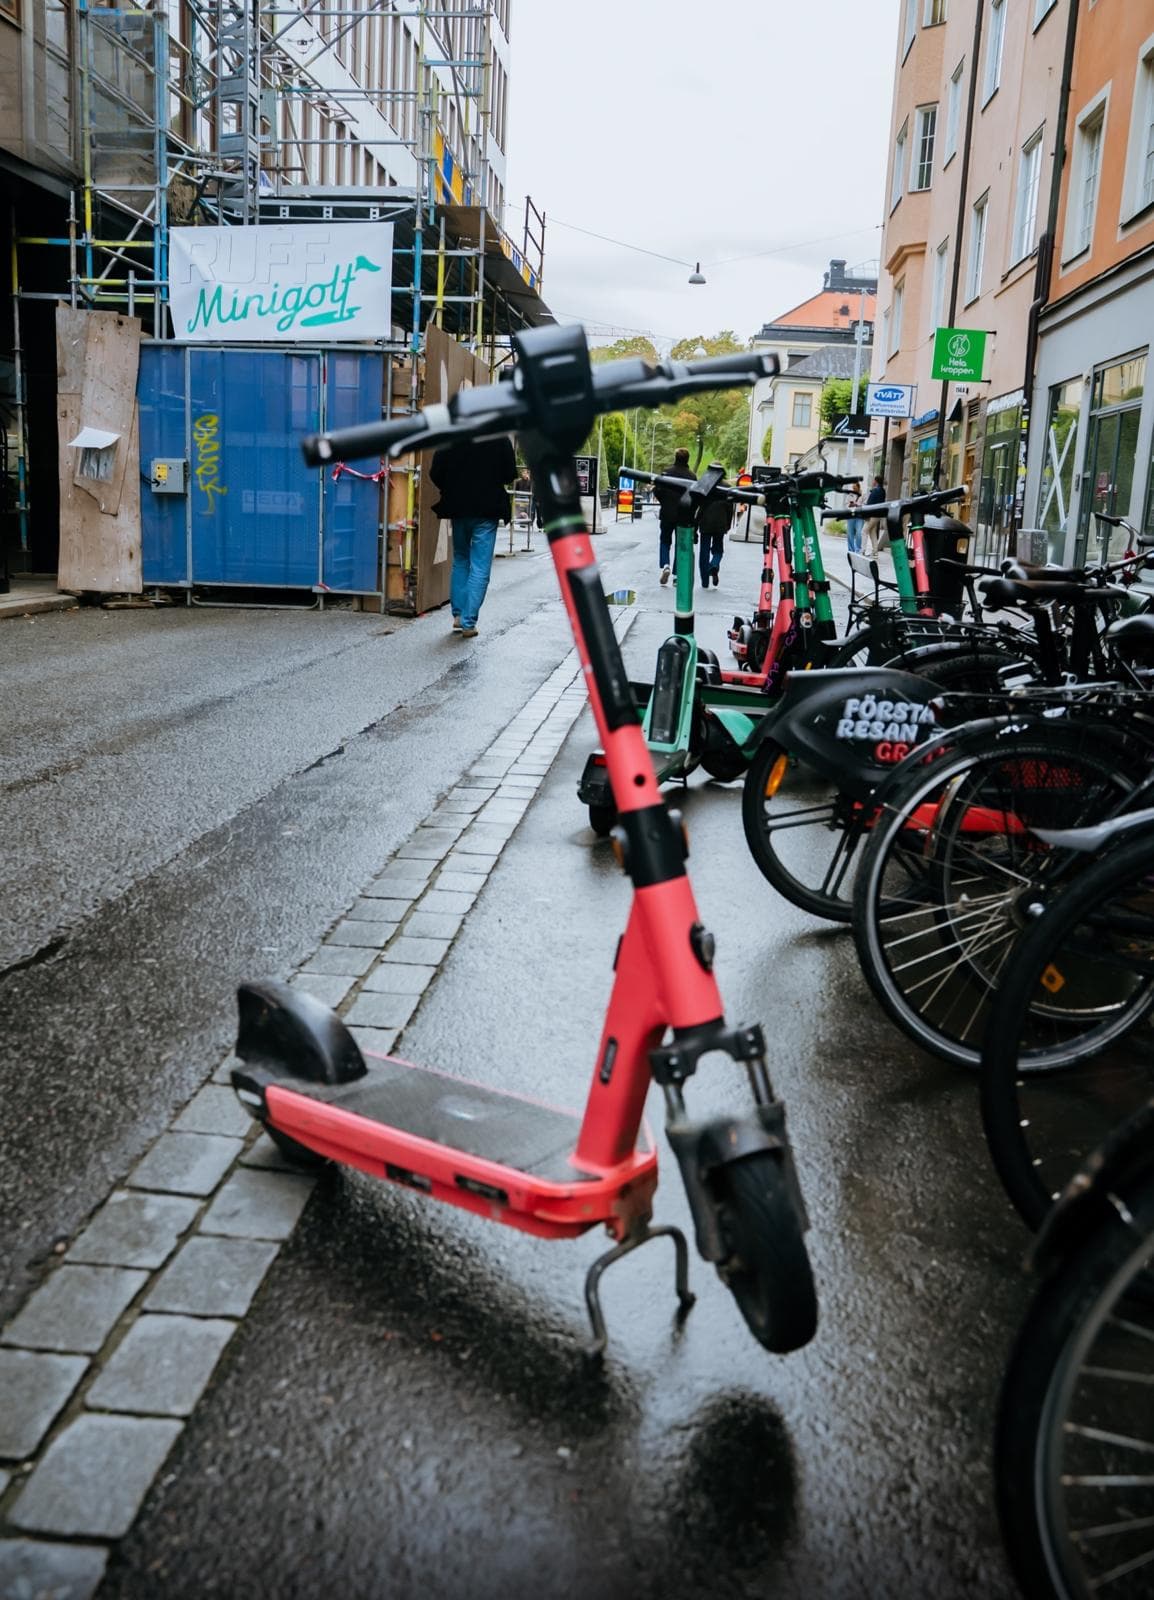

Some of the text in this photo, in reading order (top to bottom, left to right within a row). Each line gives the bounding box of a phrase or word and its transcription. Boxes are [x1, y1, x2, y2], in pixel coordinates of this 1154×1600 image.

[180, 231, 331, 285] RUFF
[188, 262, 356, 332] Minigolf
[940, 364, 975, 377] kroppen
[948, 357, 967, 367] Hela
[843, 694, 936, 723] FÖRSTA
[836, 719, 918, 742] RESAN
